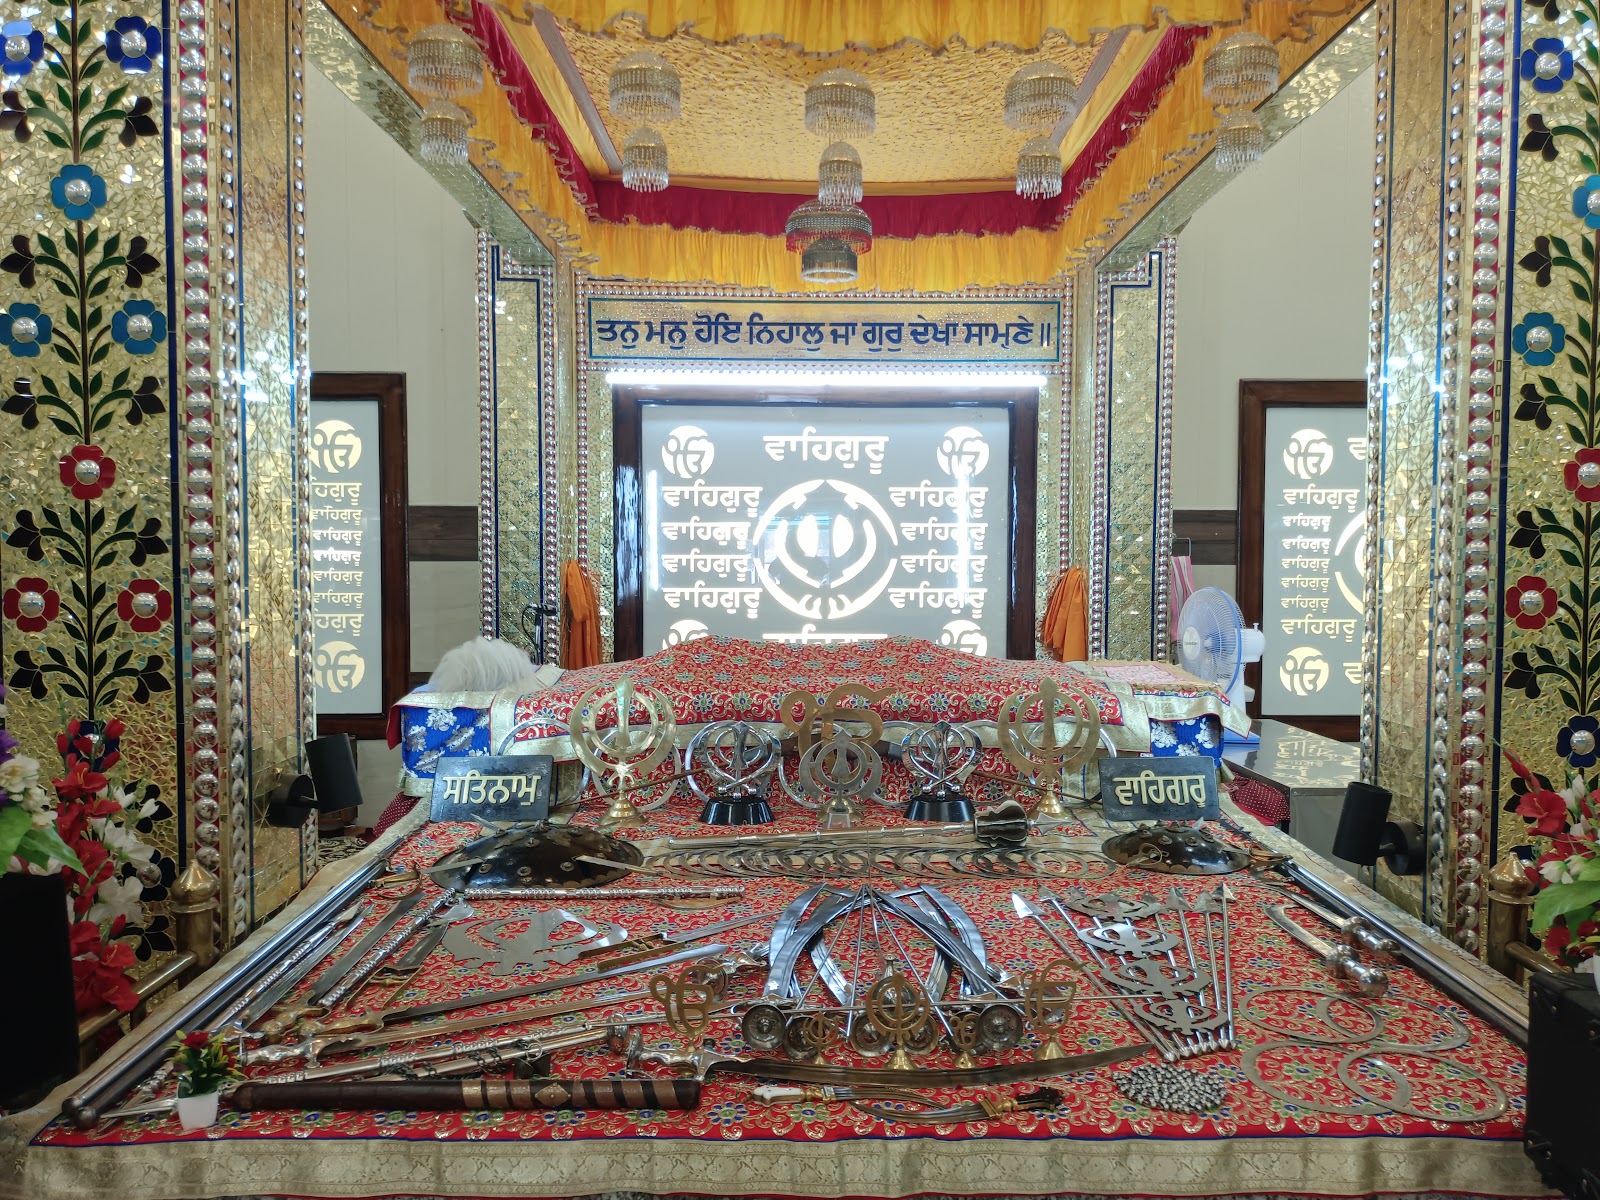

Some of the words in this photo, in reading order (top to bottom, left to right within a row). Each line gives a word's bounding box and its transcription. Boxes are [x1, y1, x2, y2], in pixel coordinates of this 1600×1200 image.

[596, 320, 640, 349] ਤਨੁ
[644, 321, 688, 350] ਮਨੁ
[692, 312, 742, 344] ਹੋਇ
[747, 312, 825, 352] ਨਿਹਾਲੁ
[829, 322, 857, 345] ਜਾ
[862, 322, 904, 352] ਗੁਰੁ
[908, 314, 958, 346] ਦੇਖਾ
[763, 426, 889, 475] ਵਾਹਿਗੁਰੂ
[661, 479, 763, 518] ਵਾਹਿਗੁਰੂ
[1283, 483, 1360, 513] ਵਾਹਿਗੁਰੂ
[312, 527, 363, 546] ਵਾਹਿਗੁਰੂ
[661, 516, 751, 549] ਵਾਹਿਗੁਰੂ
[1282, 513, 1331, 532] ਵਾਹਿਗੁਰੂ
[312, 547, 362, 566] ਵਾਹਿਗੁਰੂ
[1282, 535, 1331, 554] ਵਾਹਿਗੁਰੂ
[313, 567, 363, 586] ਵਾਹਿਗੁਰੂ
[661, 548, 751, 582] ਵਾਹਿਗੁਰੂ
[1281, 555, 1330, 574] ਵਾਹਿਗੁਰੂ
[1281, 575, 1330, 592] ਵਾਹਿਗੁਰੂ
[661, 580, 763, 619] ਵਾਹਿਗੁਰੂ
[888, 580, 988, 619] ਵਾਹਿਗੁਰੂ
[1281, 594, 1330, 613] ਵਾਹਿਗੁਰੂ
[1281, 614, 1357, 642] ਵਾਹਿਗੁਰੂ
[443, 770, 541, 806] ਸਤਿਨਾਮੁ
[1112, 770, 1205, 808] ਵਾਹਿਗੁਰੂ
